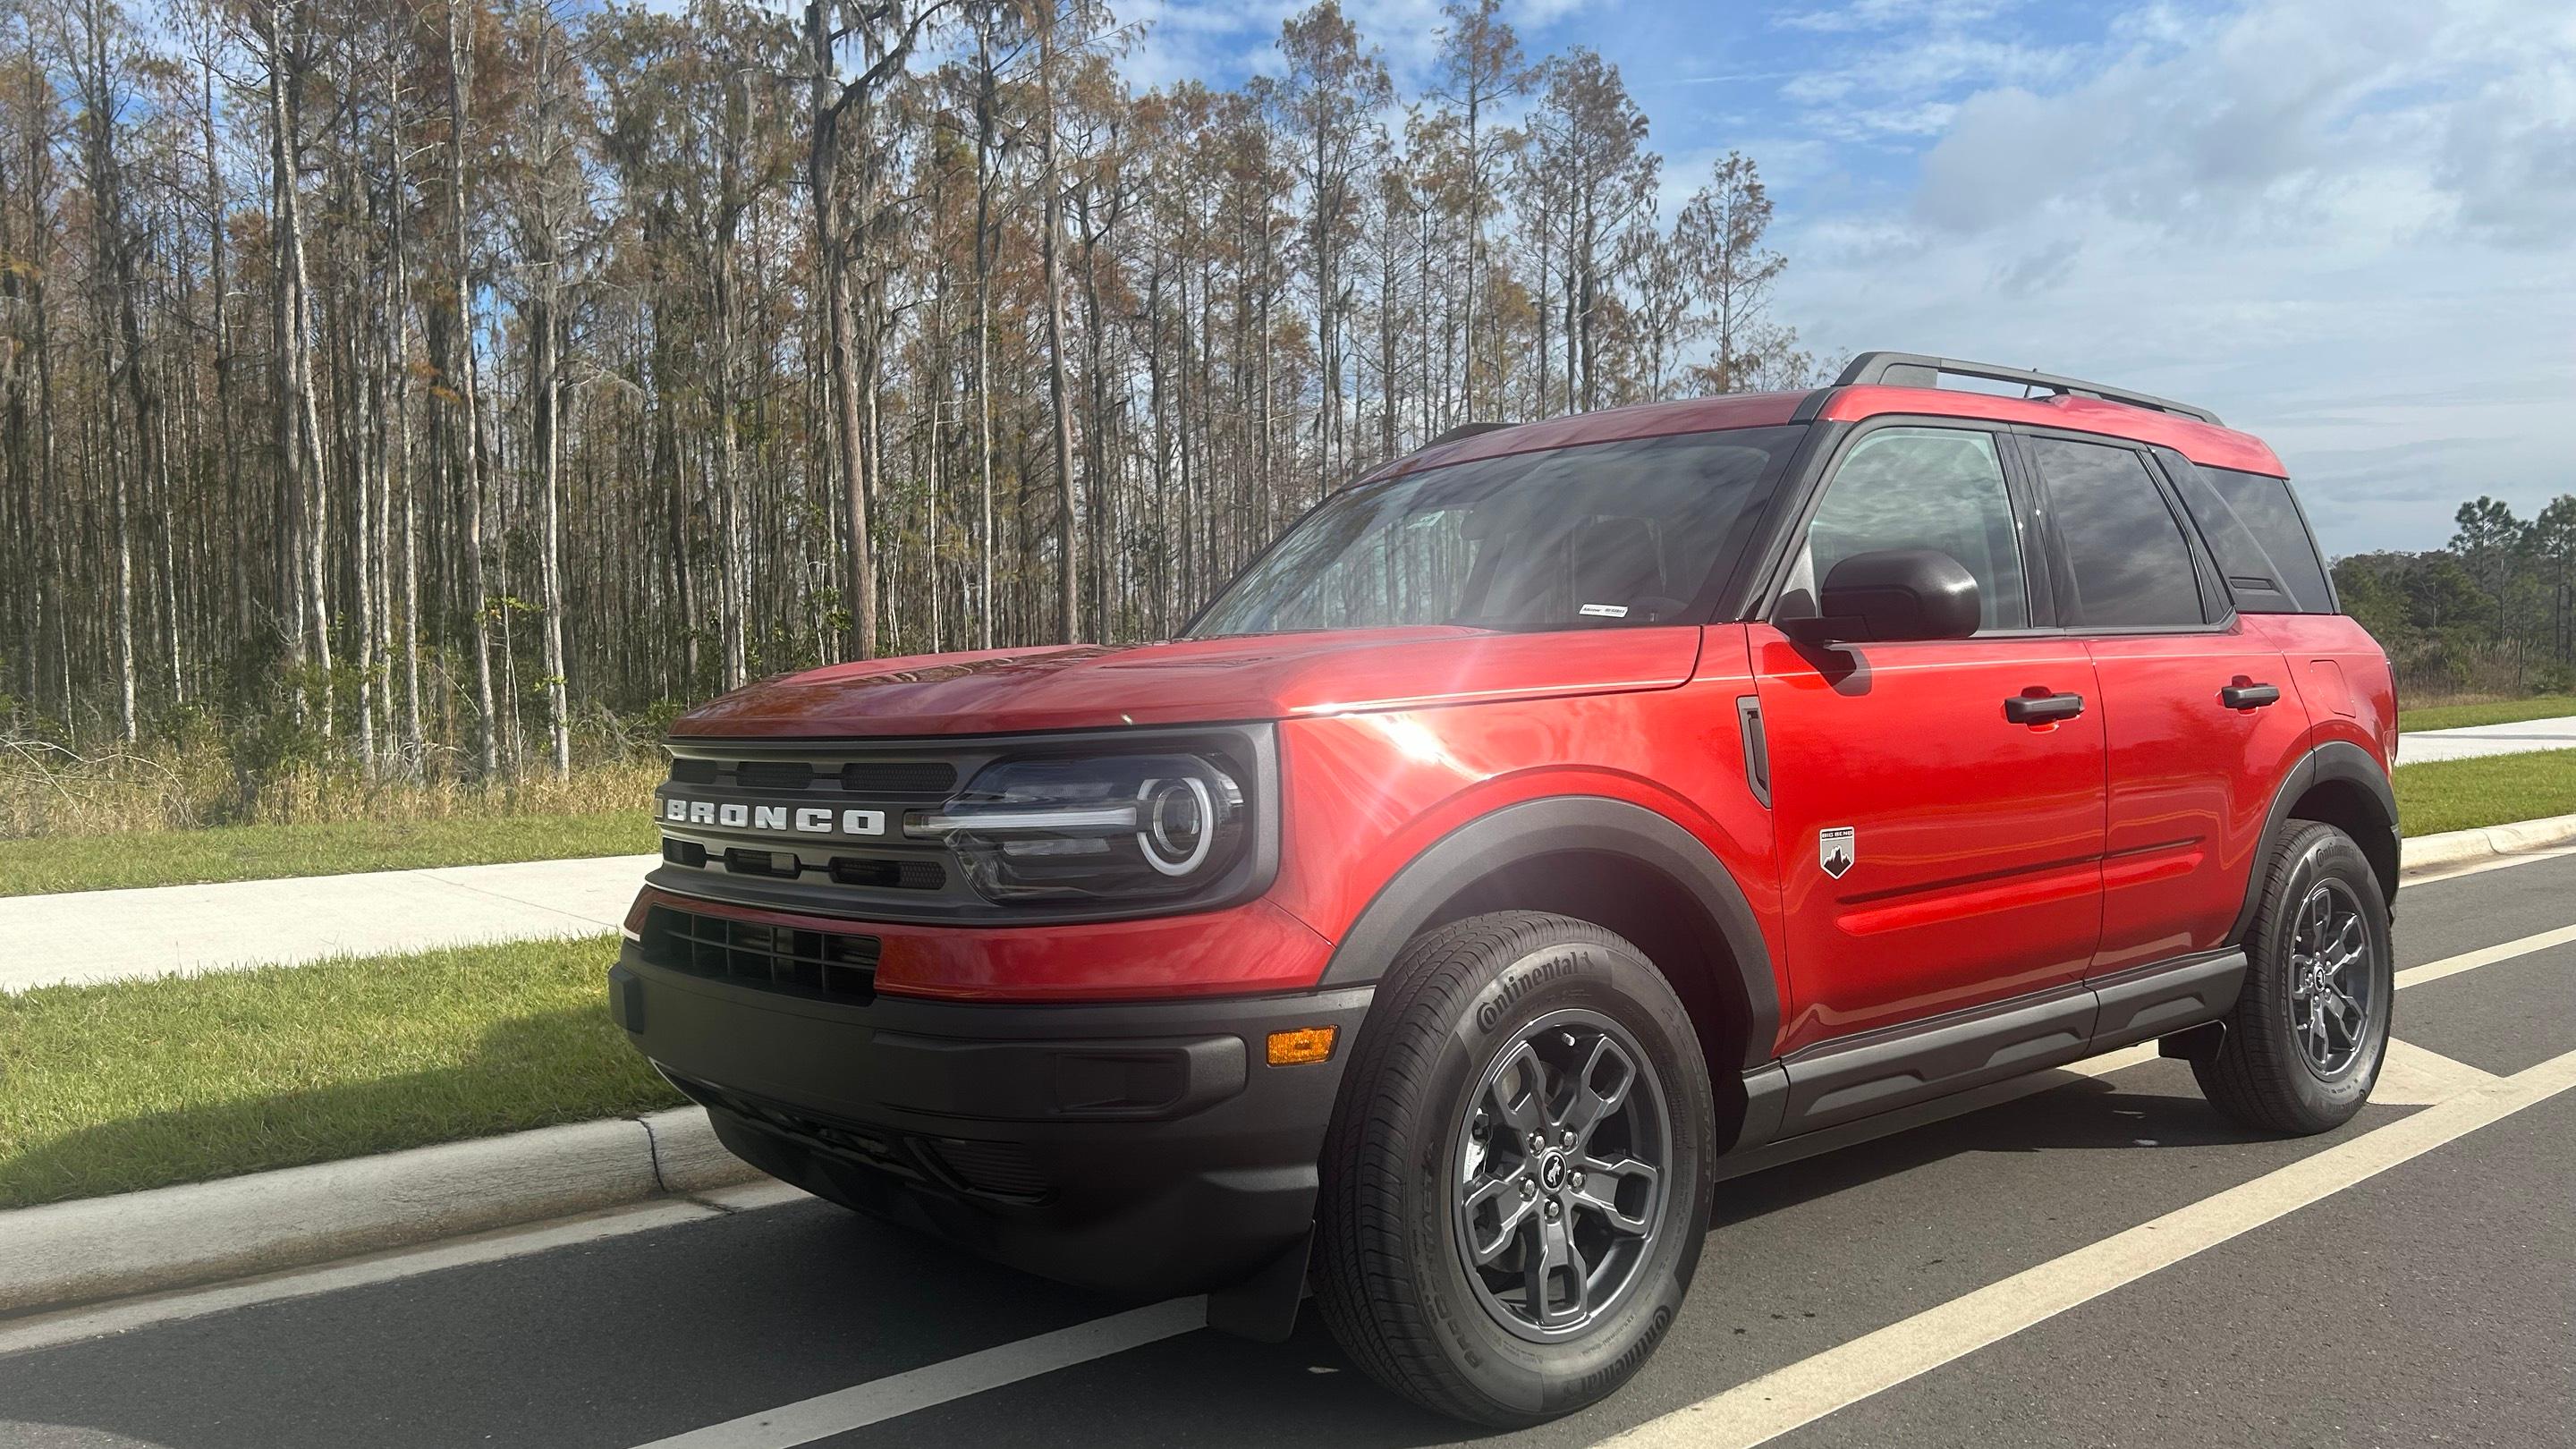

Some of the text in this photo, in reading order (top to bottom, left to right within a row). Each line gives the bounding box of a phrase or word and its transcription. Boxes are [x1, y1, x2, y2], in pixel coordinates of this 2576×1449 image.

[666, 799, 886, 835] BRONCO
[1476, 951, 1580, 1034] Continental
[1580, 1305, 1672, 1394] Continental
